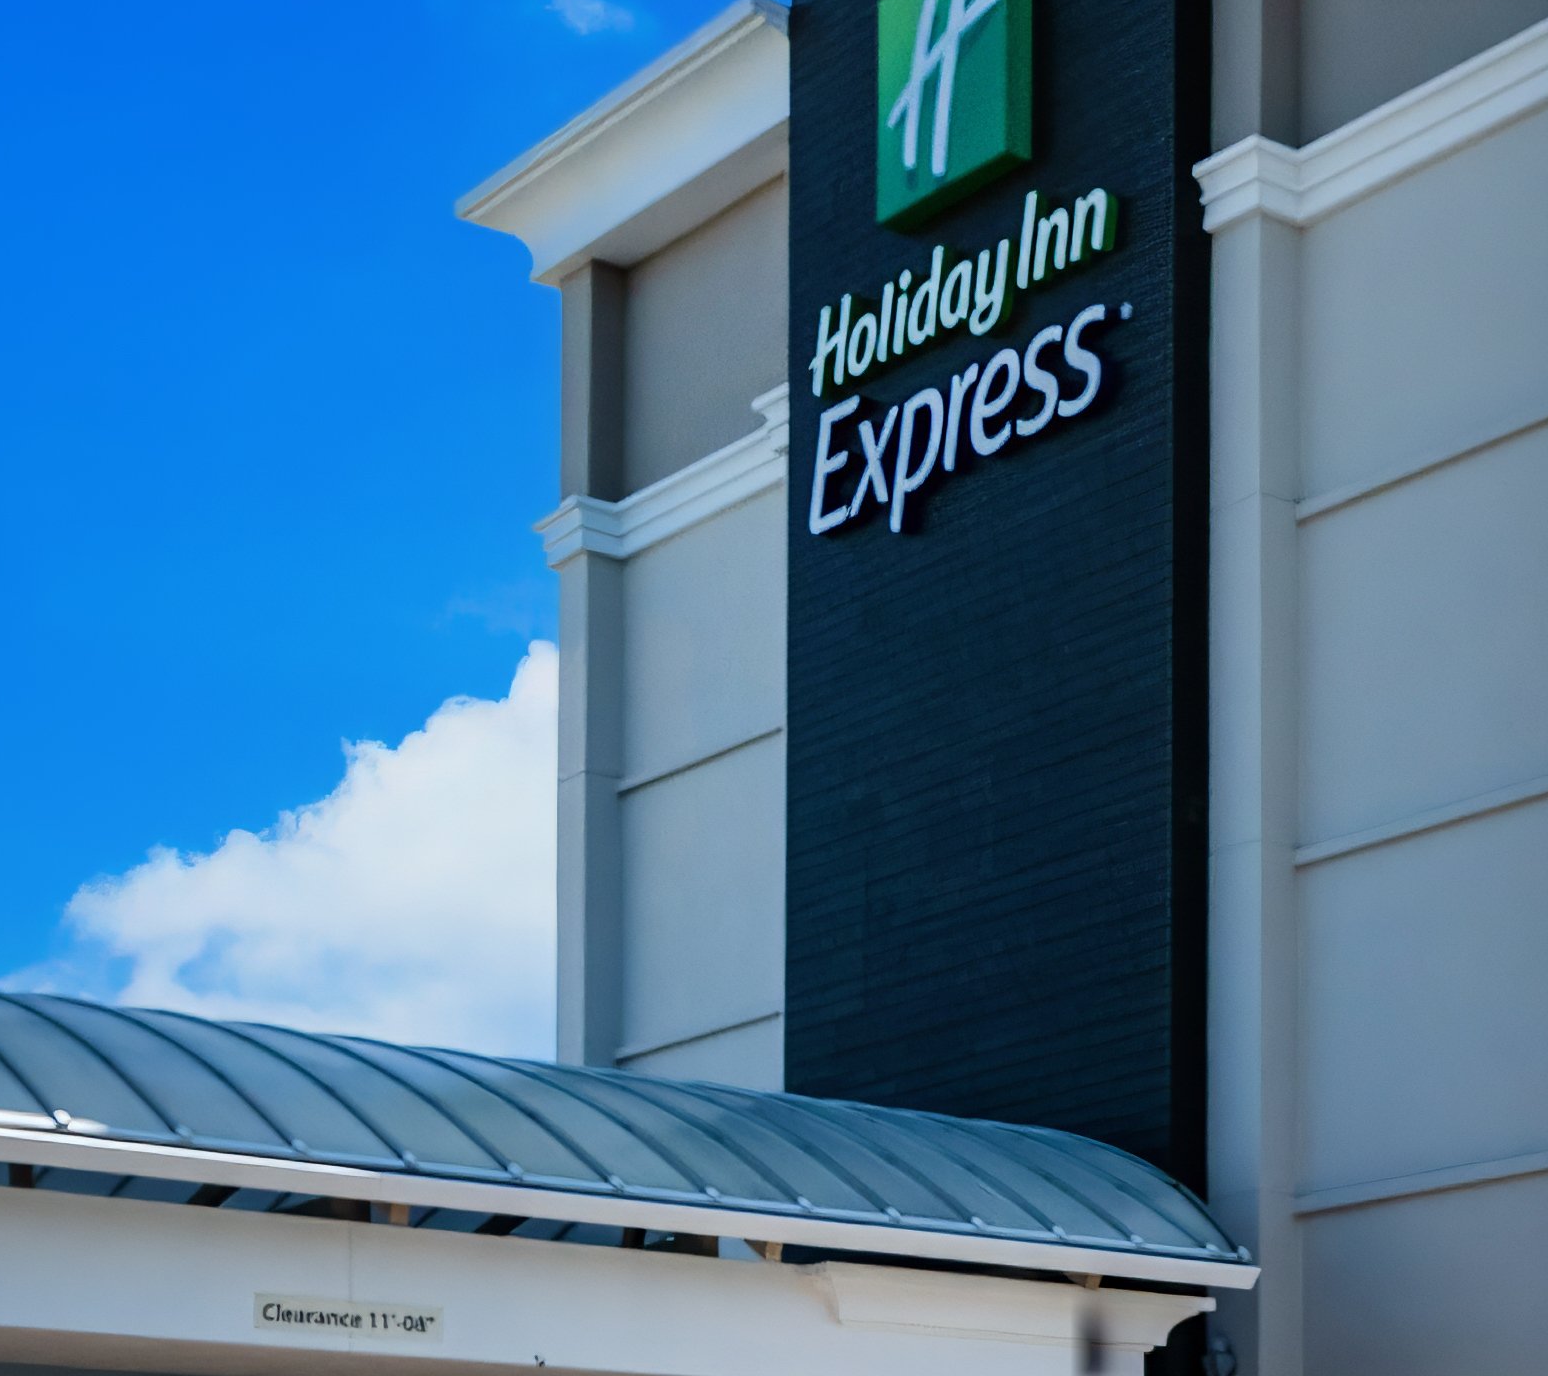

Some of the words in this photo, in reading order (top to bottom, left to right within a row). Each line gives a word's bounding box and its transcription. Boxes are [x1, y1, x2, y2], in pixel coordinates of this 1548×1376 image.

[808, 238, 1010, 397] Holiday
[1017, 188, 1108, 289] Inn
[809, 304, 1106, 535] Express
